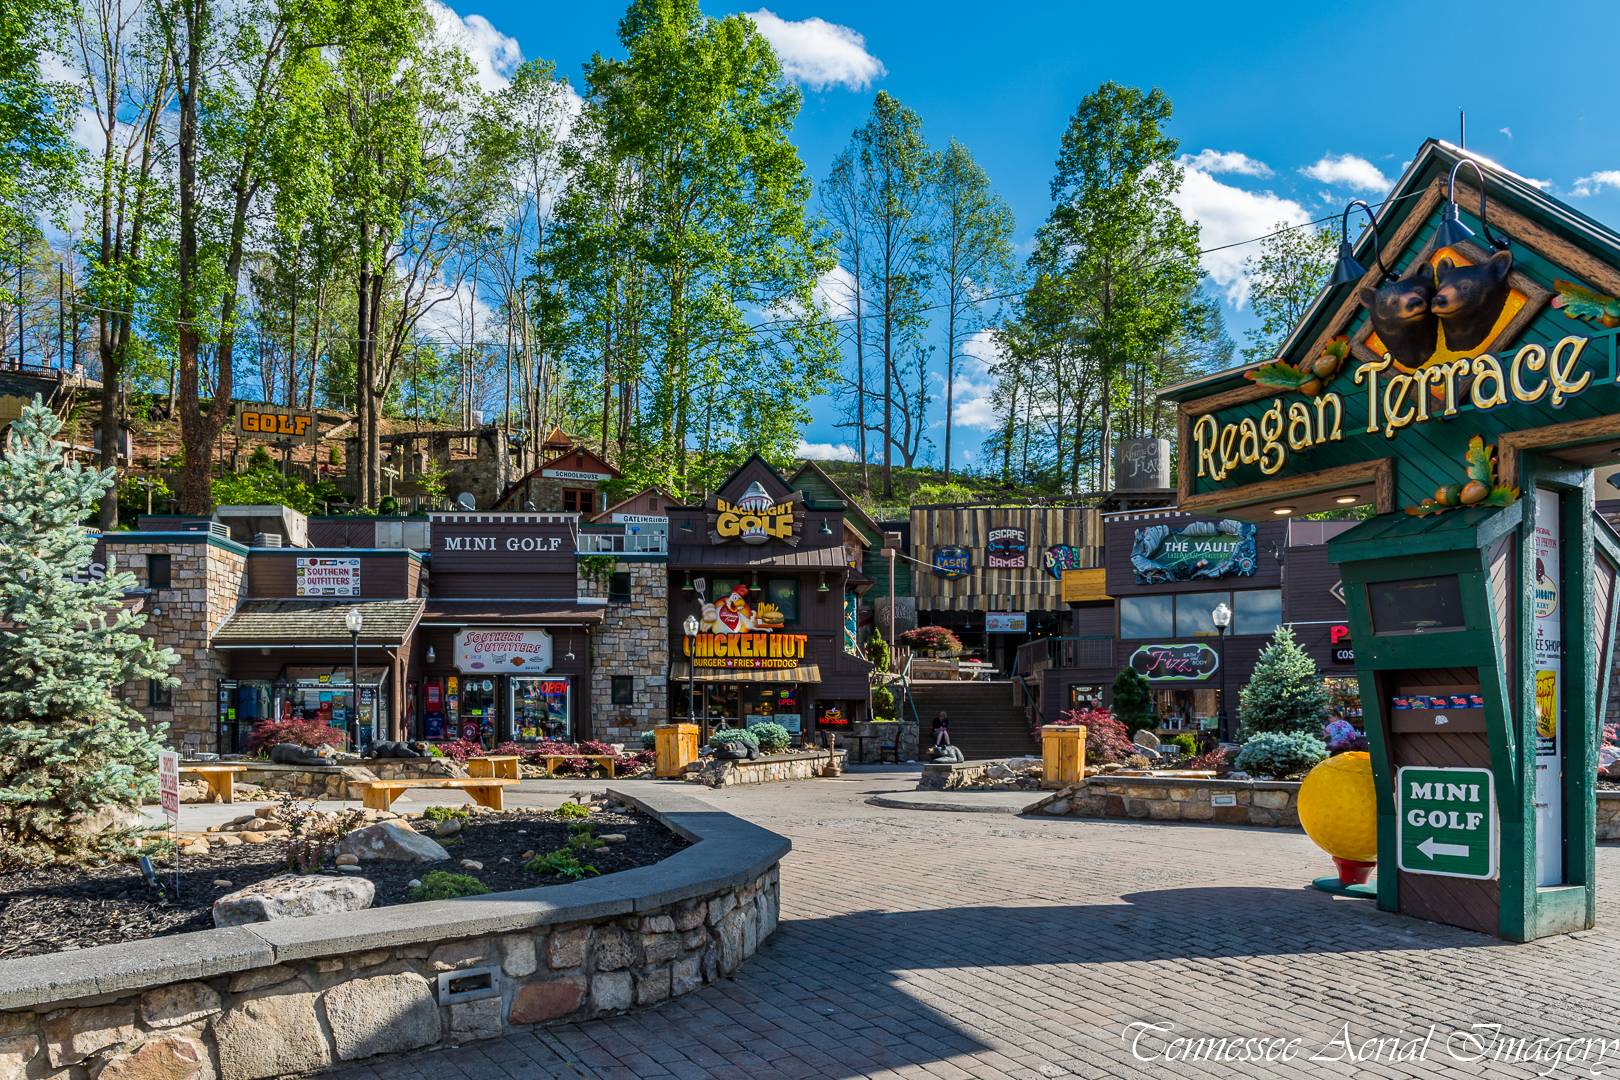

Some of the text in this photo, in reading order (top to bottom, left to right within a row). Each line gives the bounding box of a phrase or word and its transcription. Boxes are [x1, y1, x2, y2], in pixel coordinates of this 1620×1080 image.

[1194, 335, 1592, 482] Reagan Terrace
[242, 412, 312, 436] GOLF
[555, 471, 599, 480] SCHOOLHOUSE
[716, 512, 794, 539] GOLF
[989, 529, 1025, 542] ESCAPE
[444, 536, 562, 551] MINI GOLF
[1165, 542, 1237, 552] THE VAULT
[989, 555, 1025, 568] GAMES
[307, 567, 349, 576] SOUTHERN
[307, 577, 350, 585] OUTFITTERS
[464, 631, 525, 646] SOUTHERN
[1330, 625, 1349, 644] P
[474, 642, 542, 654] OUTFITTERS
[683, 633, 807, 658] CHICKEN HUT
[1146, 650, 1192, 673] Fizz
[1337, 650, 1354, 659] COS
[693, 659, 797, 668] BURGERS FRIES HOTDOGS
[541, 682, 567, 694] OPEN
[1410, 782, 1480, 802] MINI
[1407, 809, 1484, 830] GOLF
